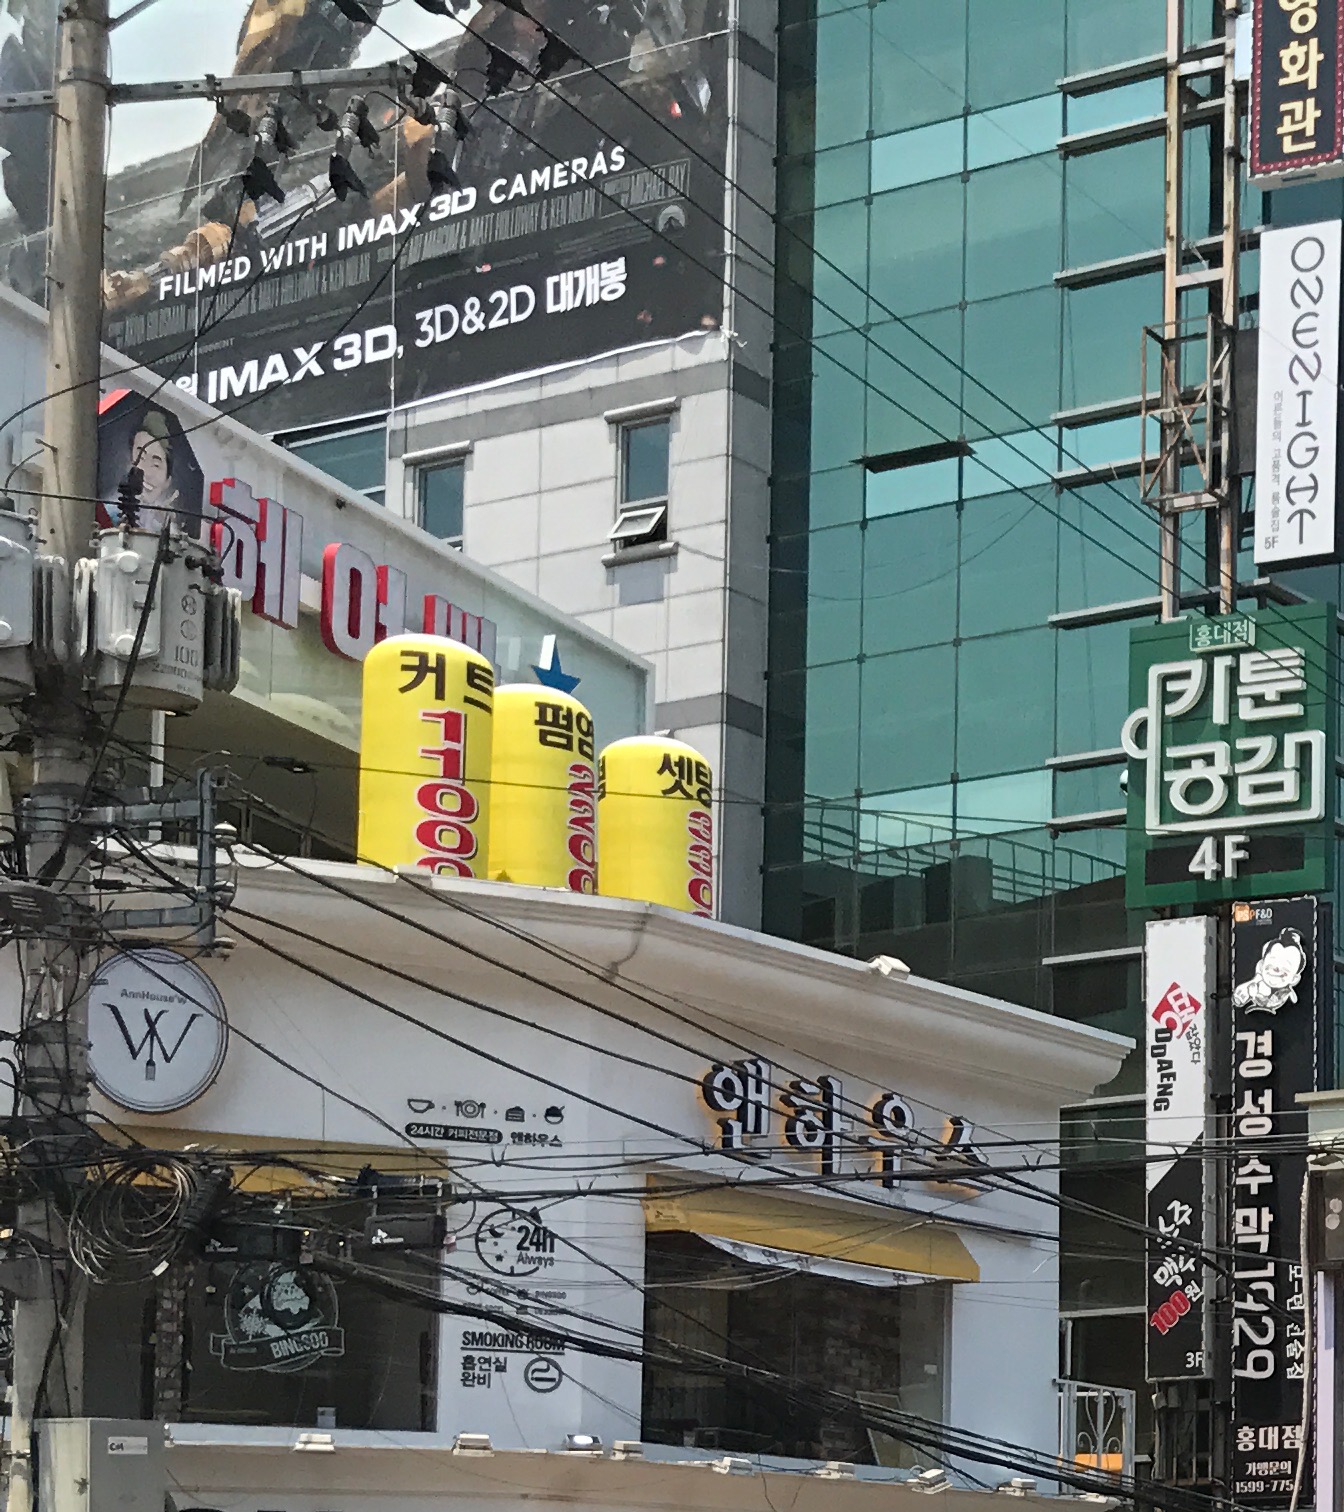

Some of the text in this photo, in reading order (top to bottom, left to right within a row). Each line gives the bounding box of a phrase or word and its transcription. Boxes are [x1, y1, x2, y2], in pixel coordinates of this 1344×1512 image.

[159, 146, 626, 300] FILMED WITH IMAX 3D CAMERAS
[209, 343, 326, 404] IMAX
[332, 325, 404, 372] 3D,
[414, 285, 536, 348] 3D&2D
[545, 257, 629, 314] 대개봉
[1264, 536, 1280, 551] 5F
[1195, 619, 1249, 647] 홍대점
[1149, 647, 1307, 727] 카툰
[1163, 729, 1326, 817] 공감
[1188, 834, 1251, 881] 4F
[1150, 1027, 1178, 1112] DDAENG
[410, 1123, 445, 1139] 24시간
[1150, 1279, 1203, 1336] 100원
[1185, 1352, 1203, 1369] 3F
[1235, 1424, 1303, 1451] 홍대점
[1235, 1480, 1302, 1494] 1599-775
